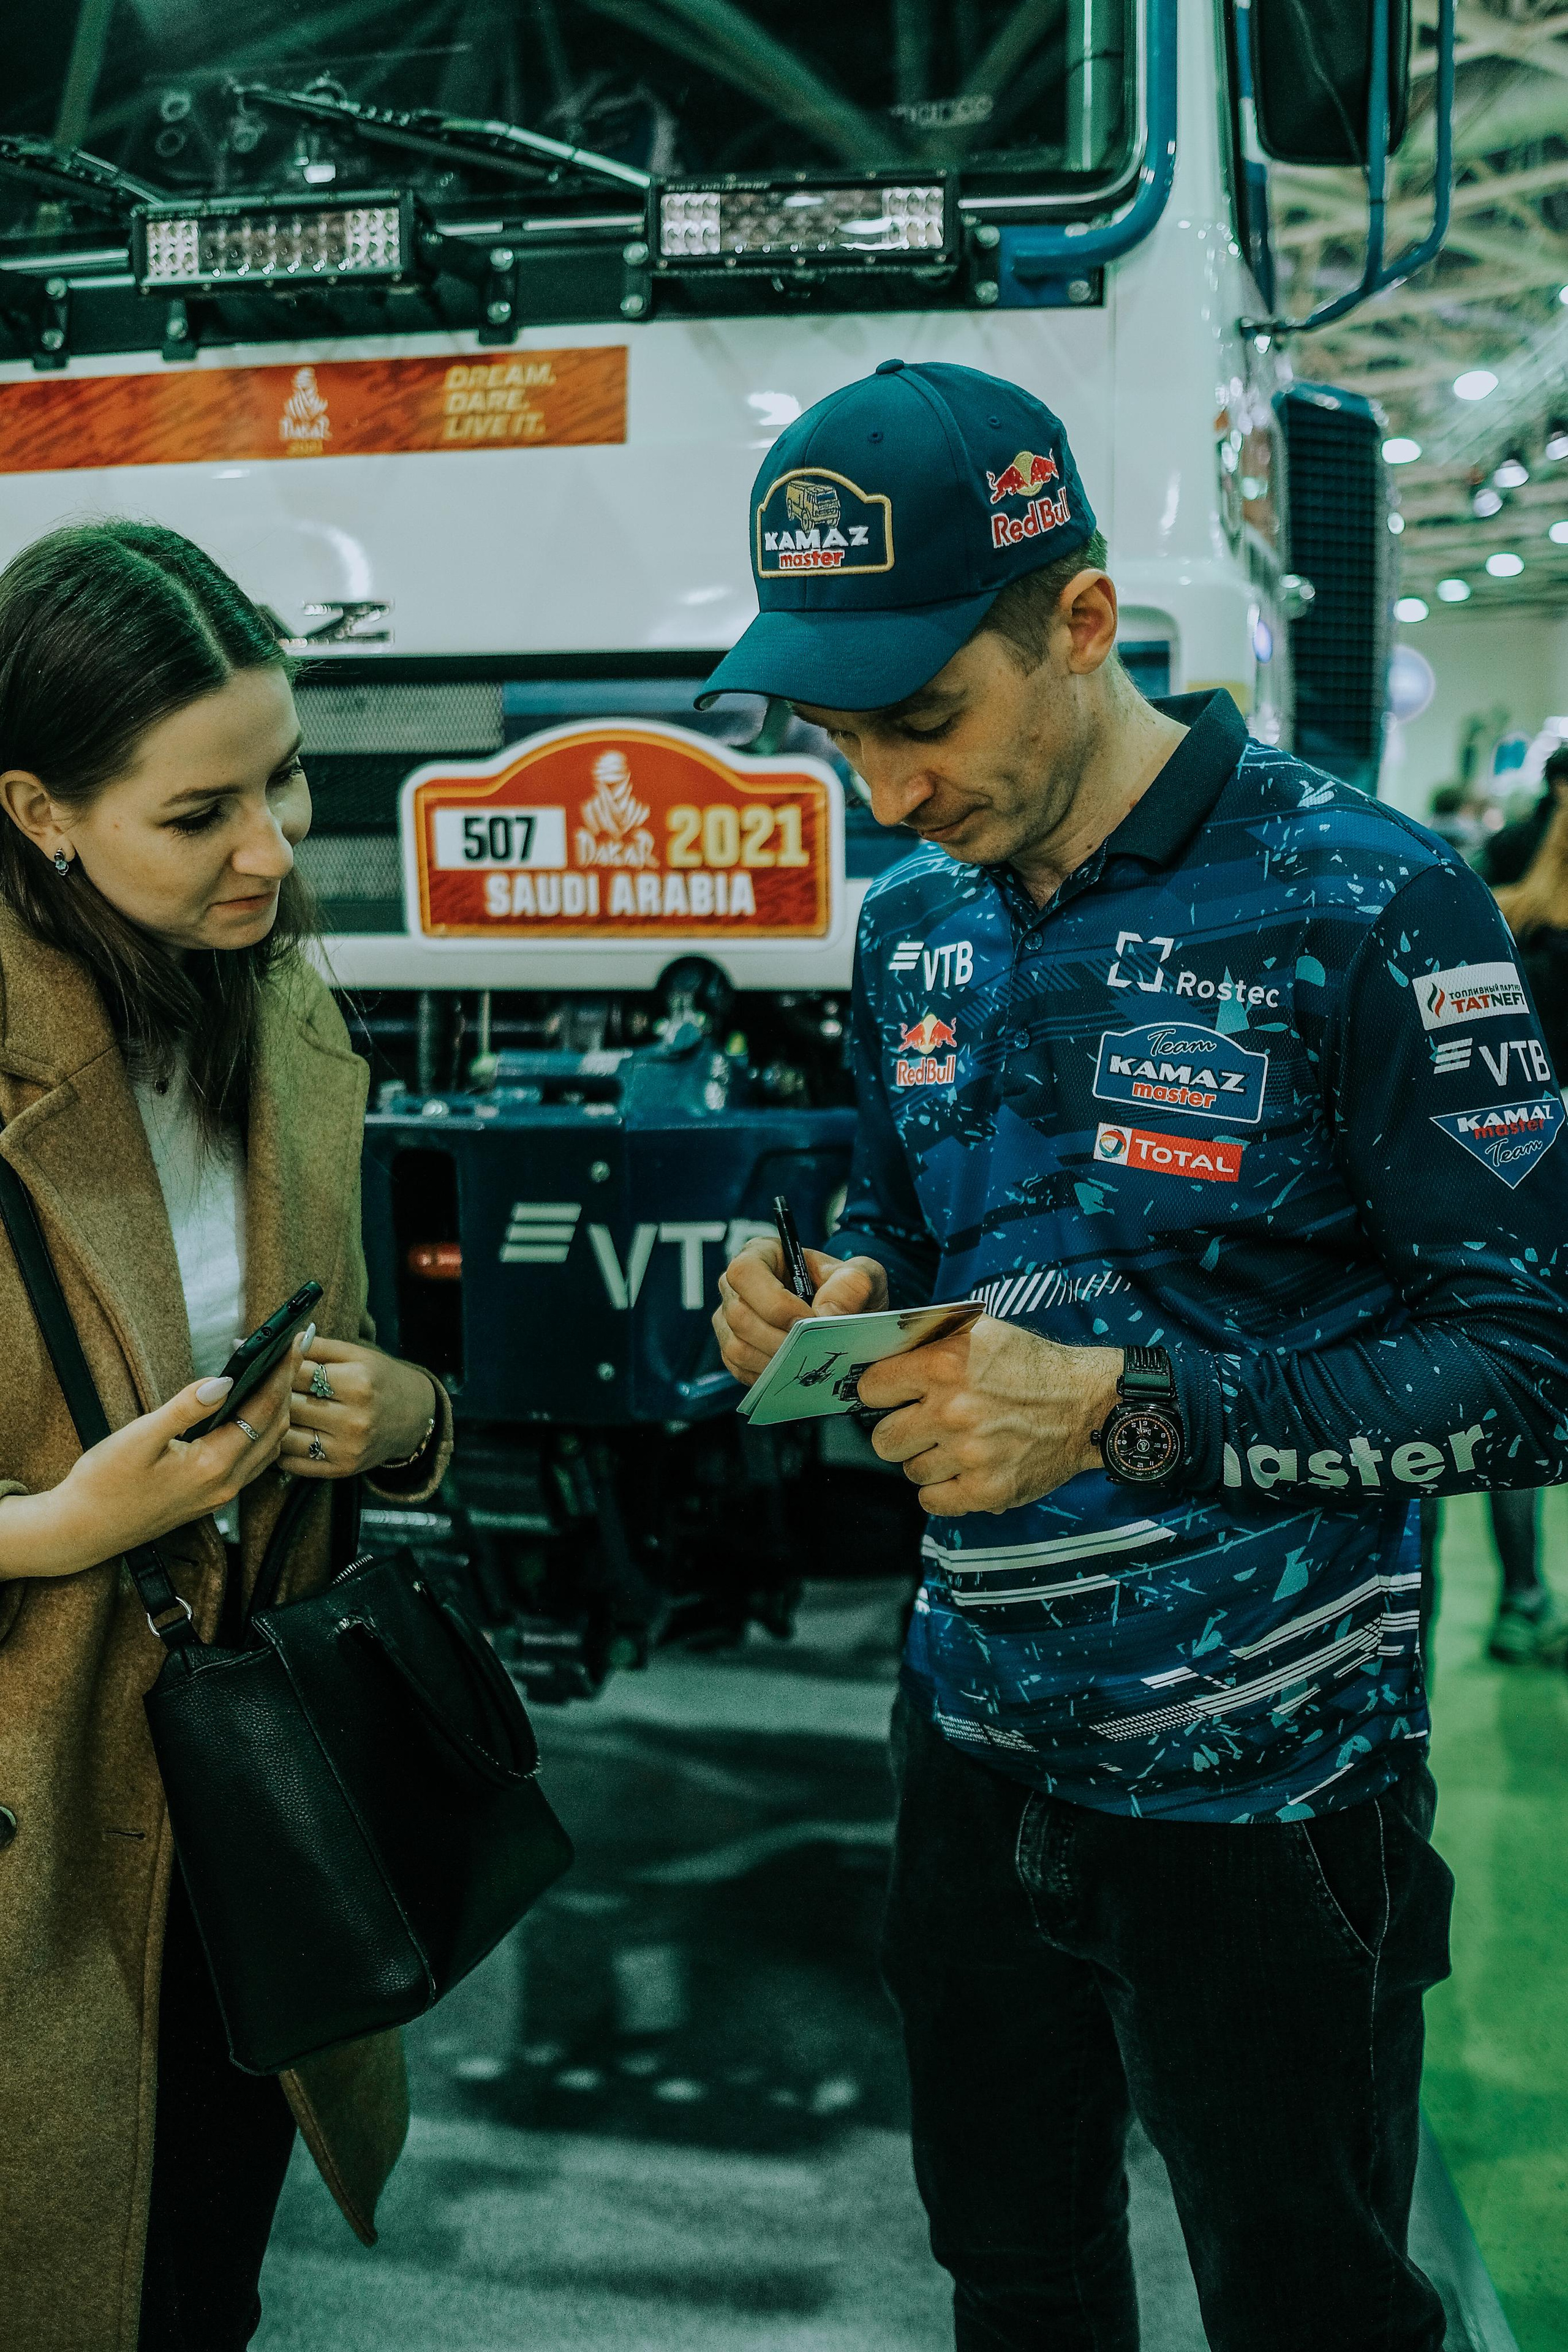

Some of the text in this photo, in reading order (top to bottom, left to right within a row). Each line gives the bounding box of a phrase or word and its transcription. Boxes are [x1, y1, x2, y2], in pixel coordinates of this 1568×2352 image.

[445, 388, 530, 414] DARE.
[443, 413, 514, 440] LIVE
[764, 525, 869, 551] KAMAZ
[779, 549, 845, 570] master
[462, 815, 537, 862] 507
[667, 803, 810, 868] 2021
[485, 870, 757, 917] SAUDI ARABIA
[923, 941, 974, 992] VTB
[1176, 971, 1280, 1008] Rostec
[1449, 984, 1499, 1000] ТОПЛИВНЫЙ
[1450, 992, 1525, 1014] TATNEFT
[1147, 1028, 1217, 1057] Team
[1109, 1055, 1245, 1093] KAMAZ
[1478, 1039, 1551, 1087] VTB
[1132, 1082, 1217, 1109] master
[1457, 1105, 1555, 1133] KAMAZ
[1473, 1118, 1545, 1140] master
[1484, 1138, 1543, 1167] Team
